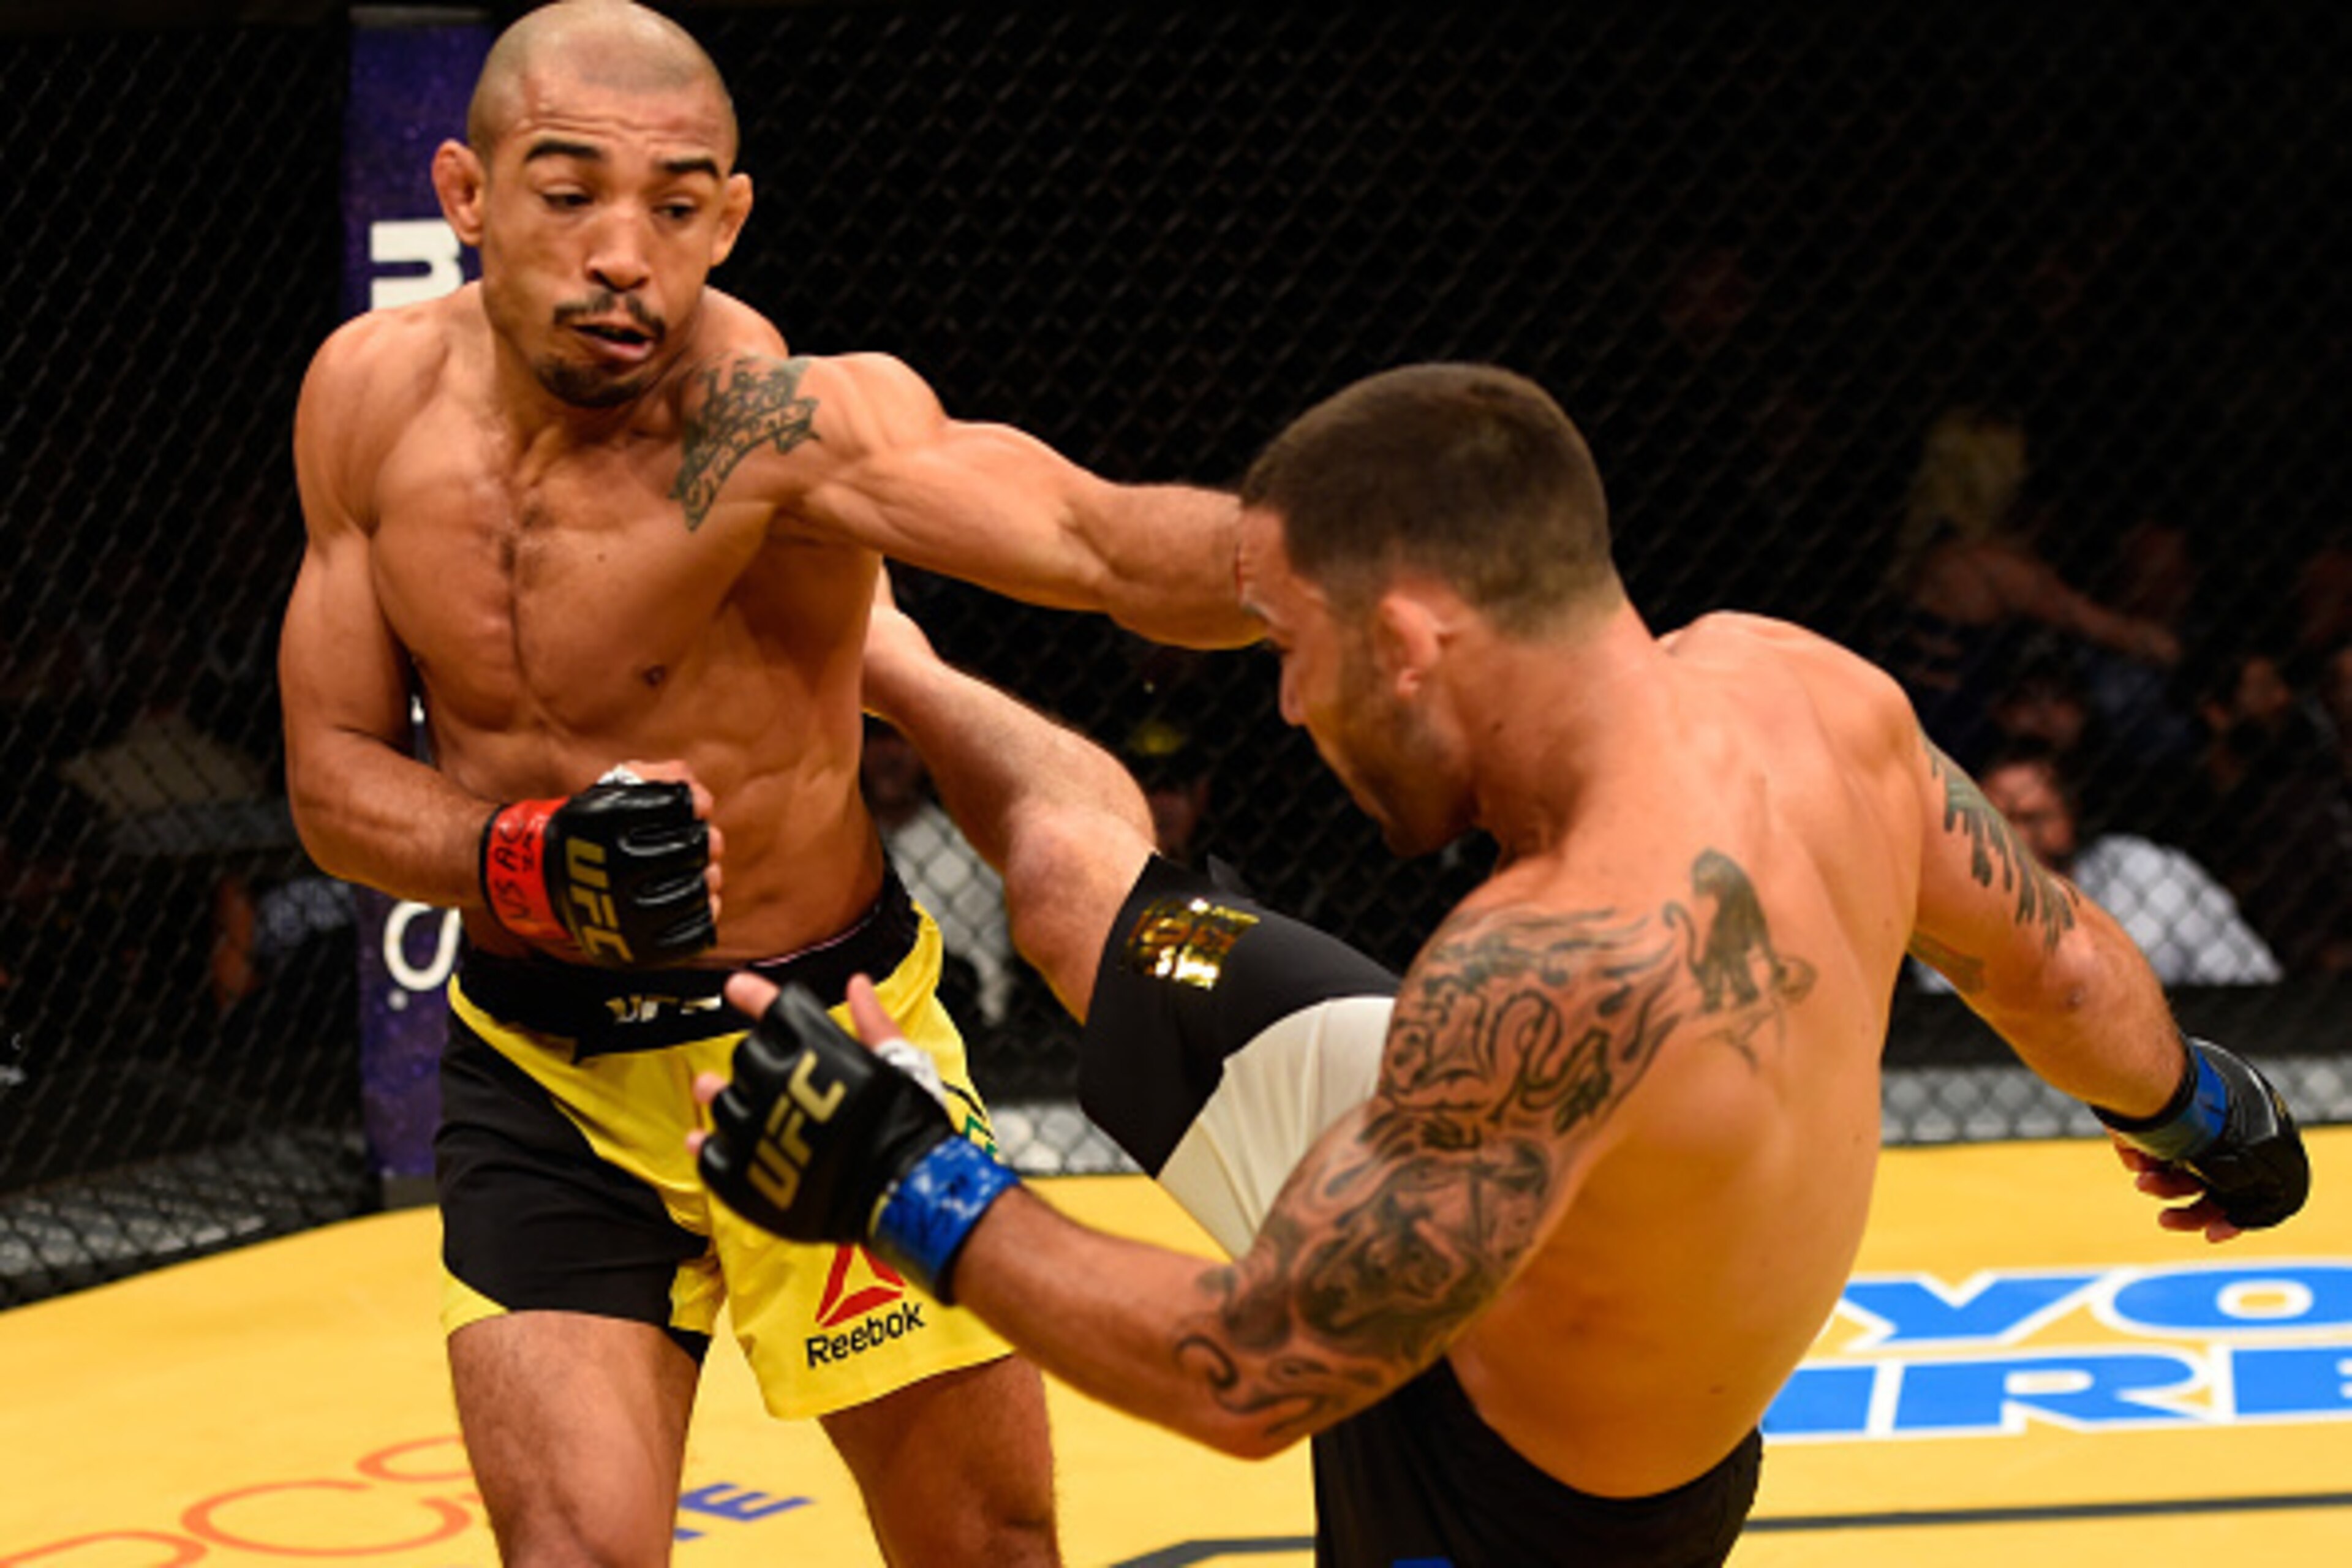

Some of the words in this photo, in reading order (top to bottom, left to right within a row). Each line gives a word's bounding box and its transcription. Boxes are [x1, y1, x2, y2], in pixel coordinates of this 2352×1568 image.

[565, 837, 635, 963] UFC
[746, 1047, 848, 1212] UFC
[805, 1301, 926, 1370] Reebok
